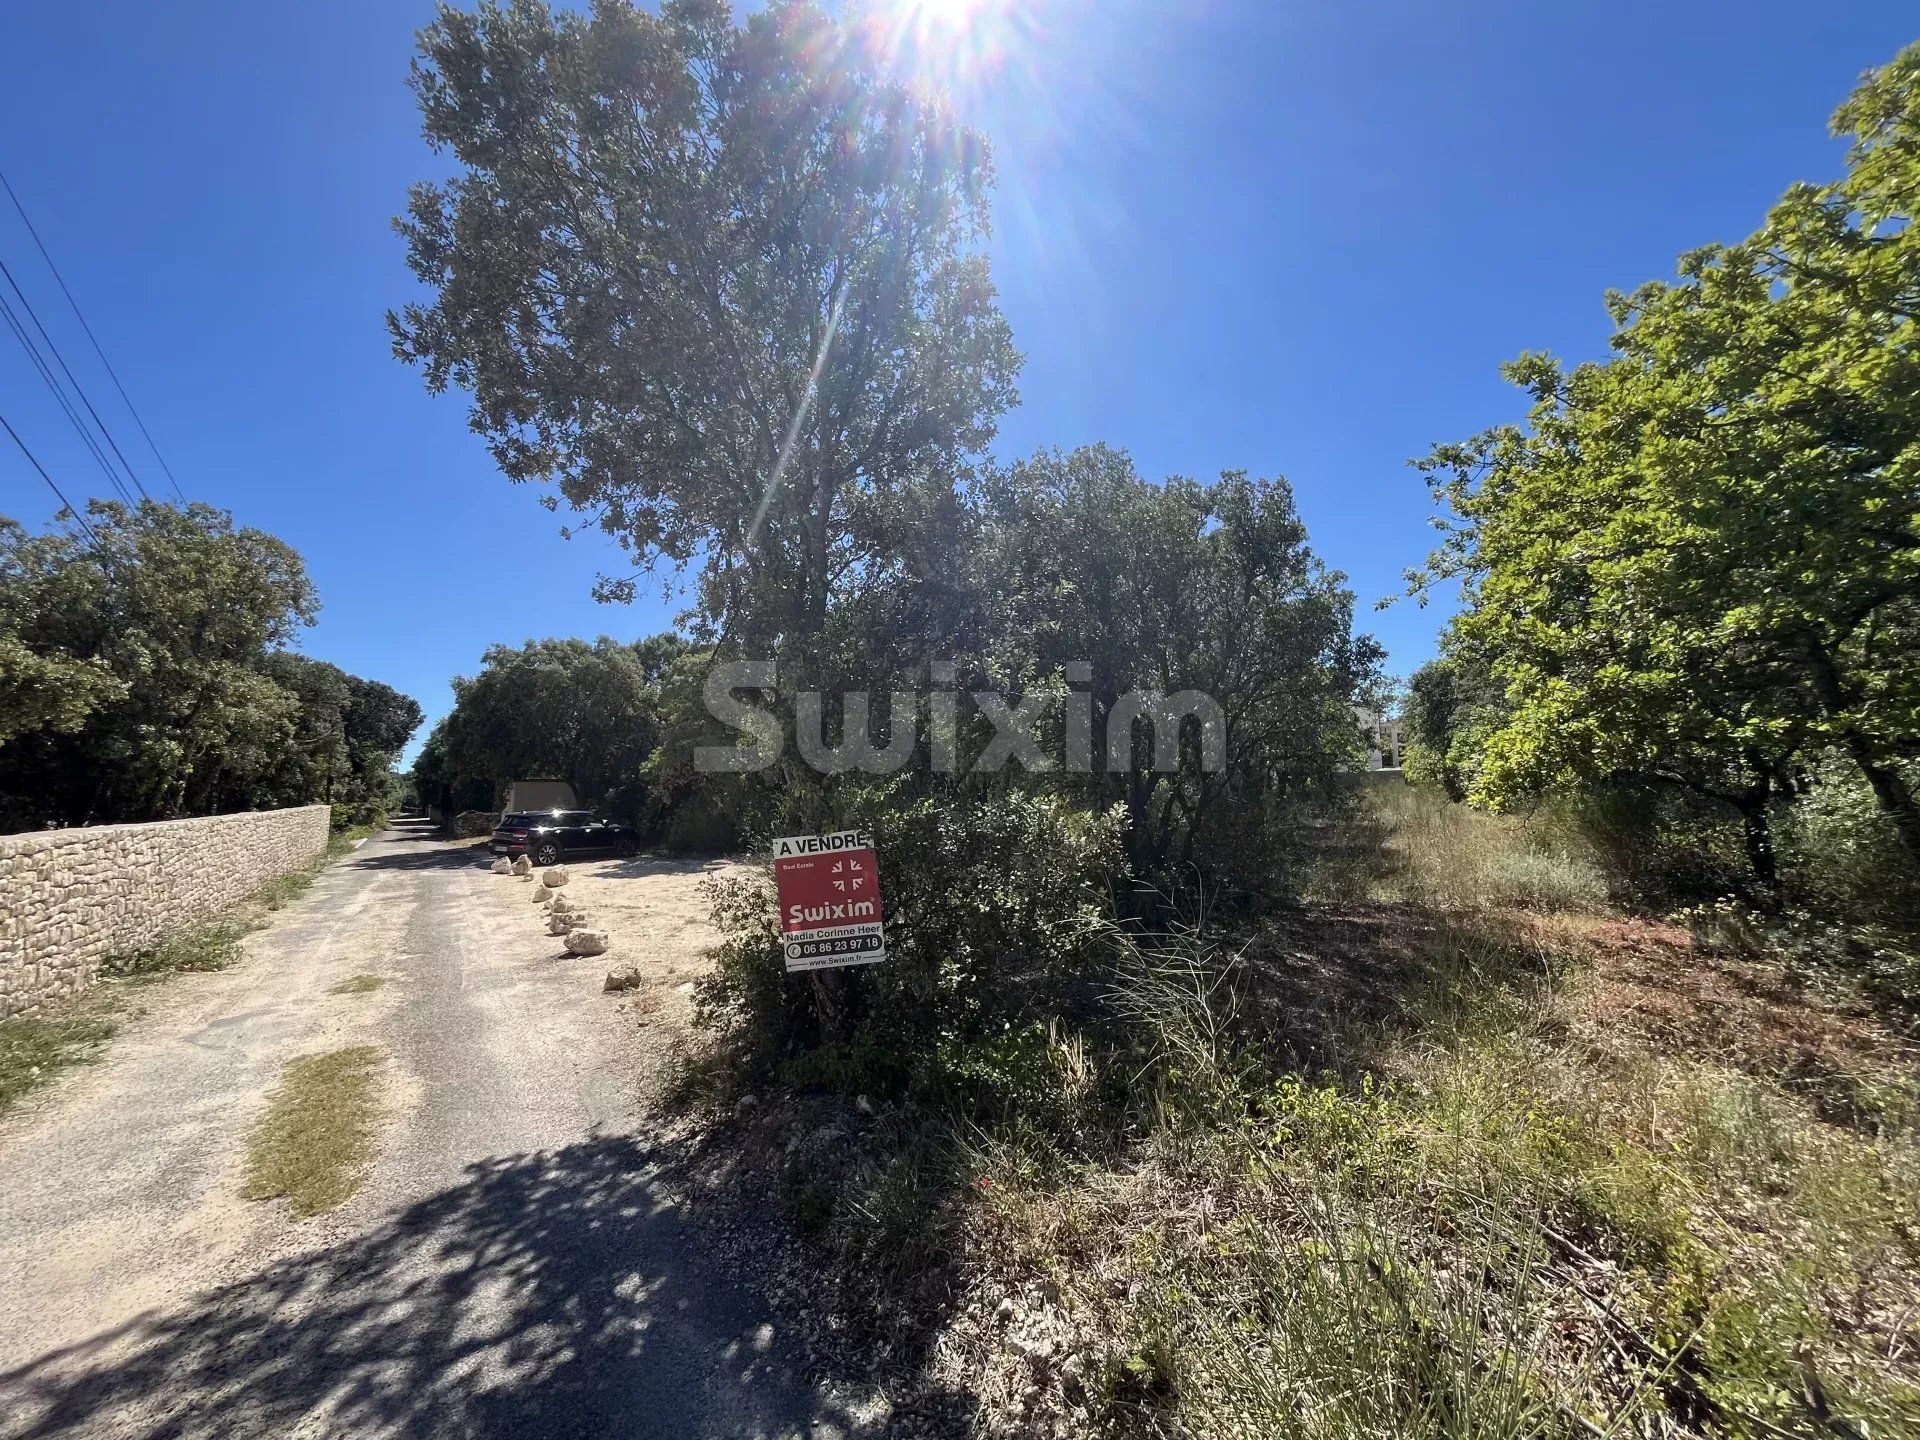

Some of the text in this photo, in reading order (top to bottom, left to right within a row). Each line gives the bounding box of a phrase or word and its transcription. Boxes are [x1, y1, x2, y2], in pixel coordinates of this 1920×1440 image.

[780, 832, 868, 855] A VENDRE
[789, 899, 874, 923] Swixim
[786, 925, 880, 941] Nadia Corinne Heer
[804, 937, 879, 954] 06 86 23 97 18
[809, 955, 862, 966] www.Swixim.fr
